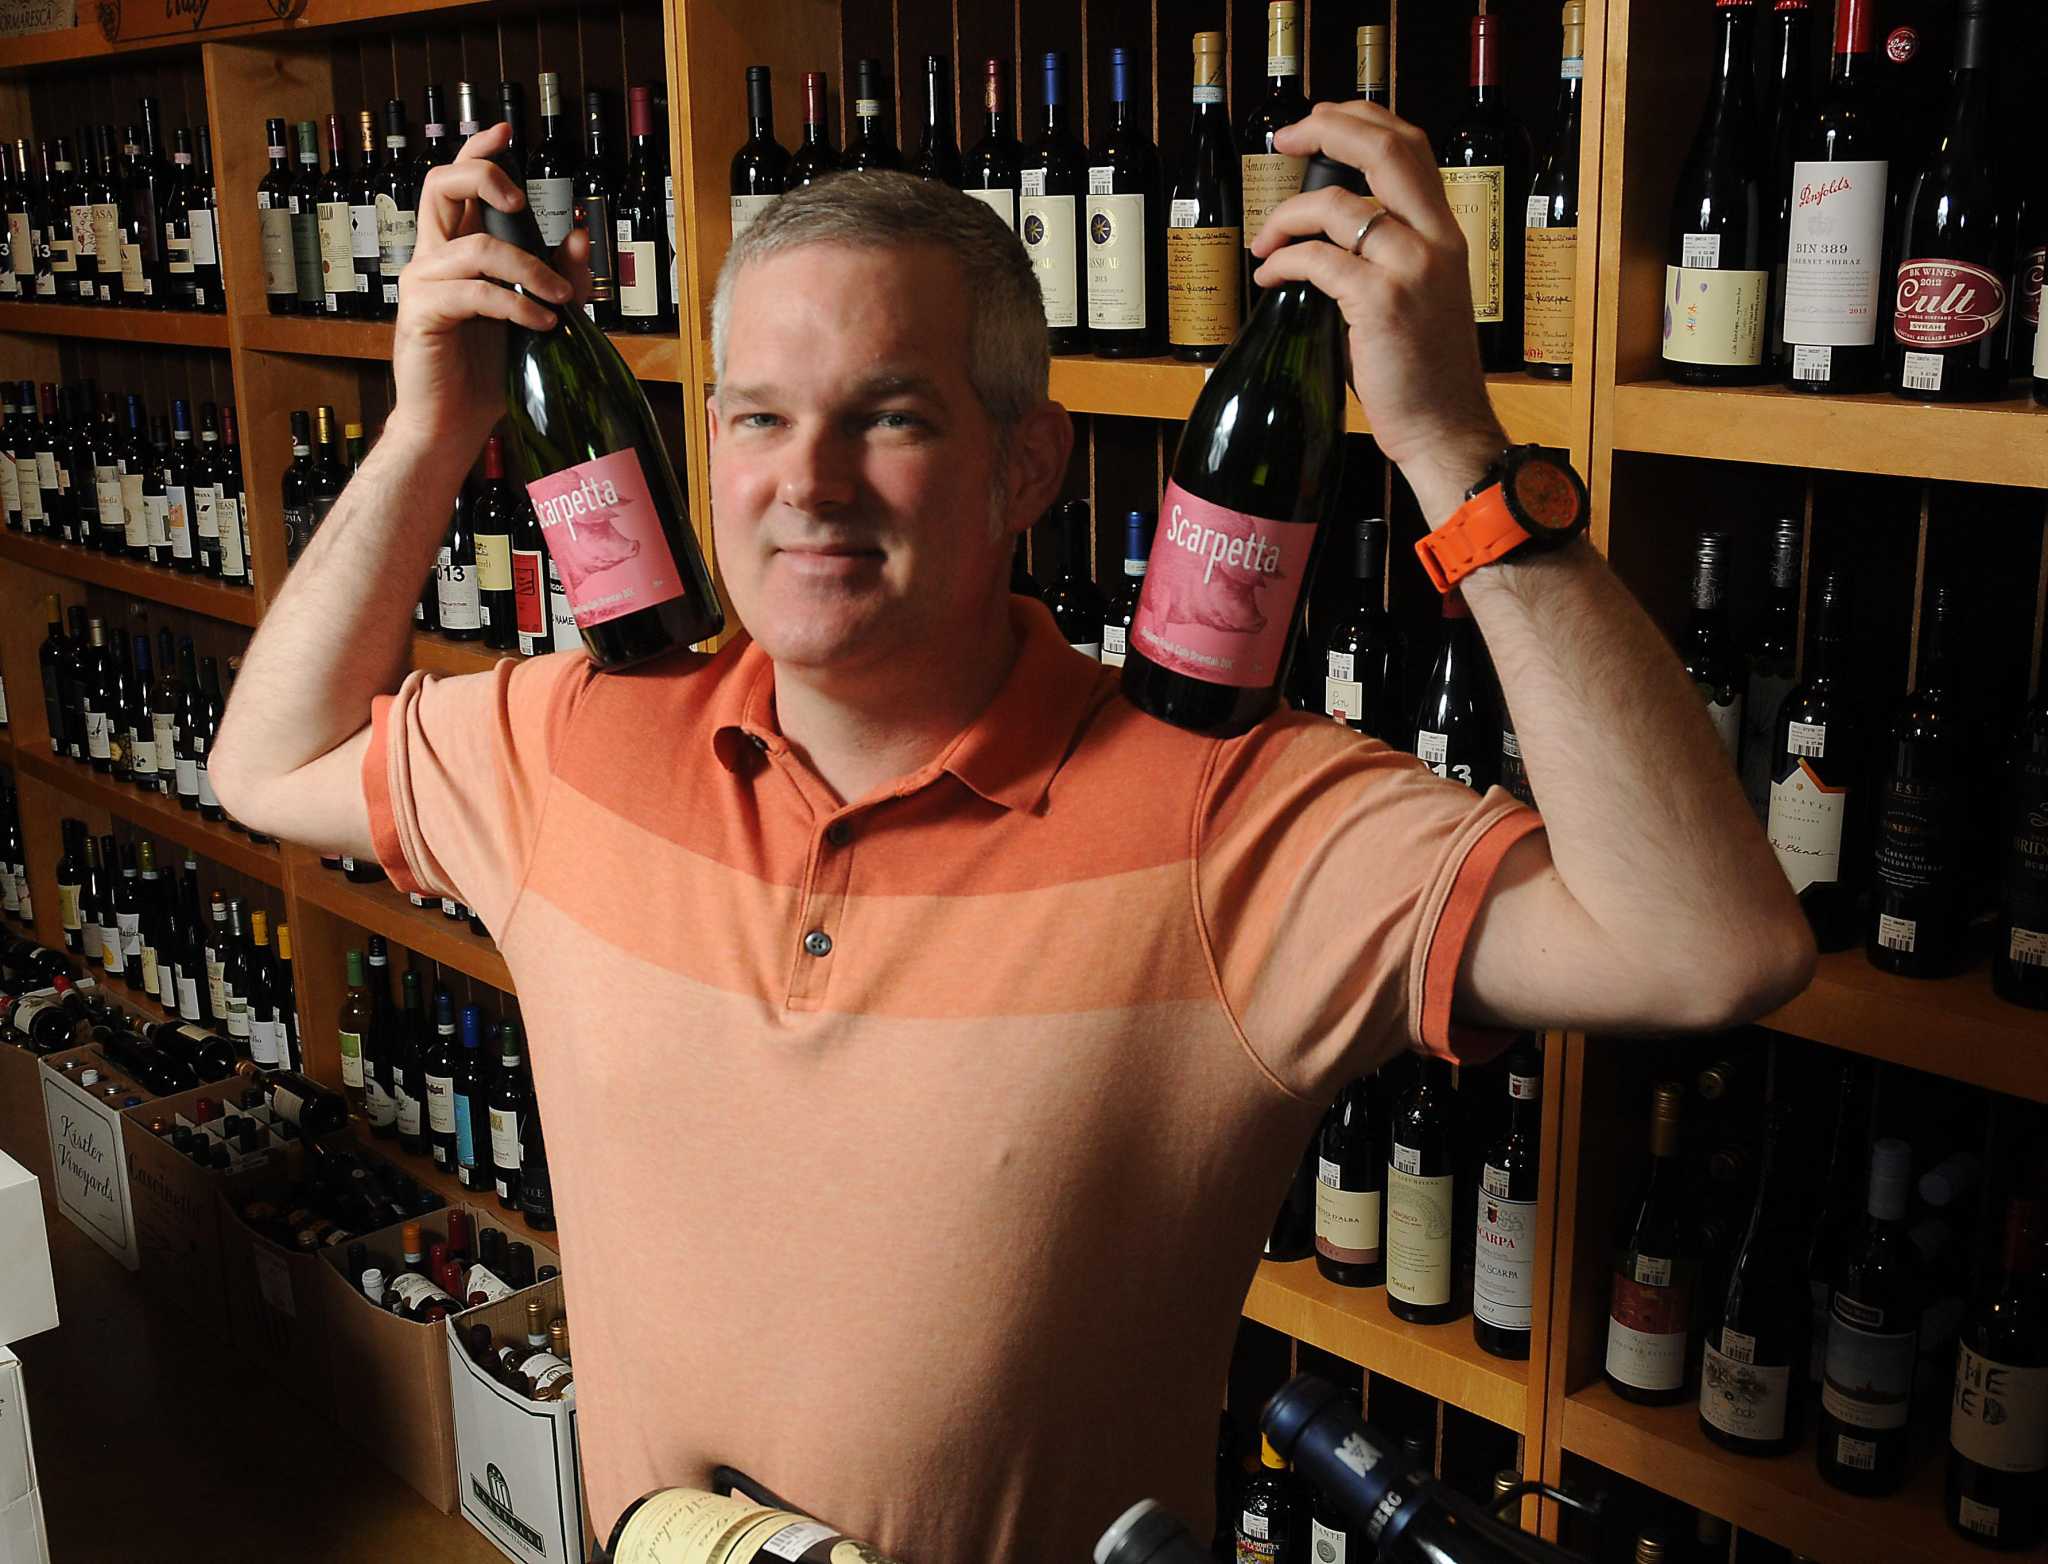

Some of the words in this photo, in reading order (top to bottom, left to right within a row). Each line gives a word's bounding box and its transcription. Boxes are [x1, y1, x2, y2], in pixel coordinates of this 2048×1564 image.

[1795, 243, 1817, 255] BIN
[1820, 242, 1849, 255] 389
[1908, 268, 1921, 278] BK
[1922, 267, 1958, 278] WINES
[1896, 278, 1976, 314] Cult
[1912, 322, 1942, 331] SYRAH
[1168, 504, 1281, 585] Scarpetta
[1785, 843, 1834, 857] Blend
[60, 1114, 104, 1164] Kistler
[58, 1143, 114, 1202] Vineyards
